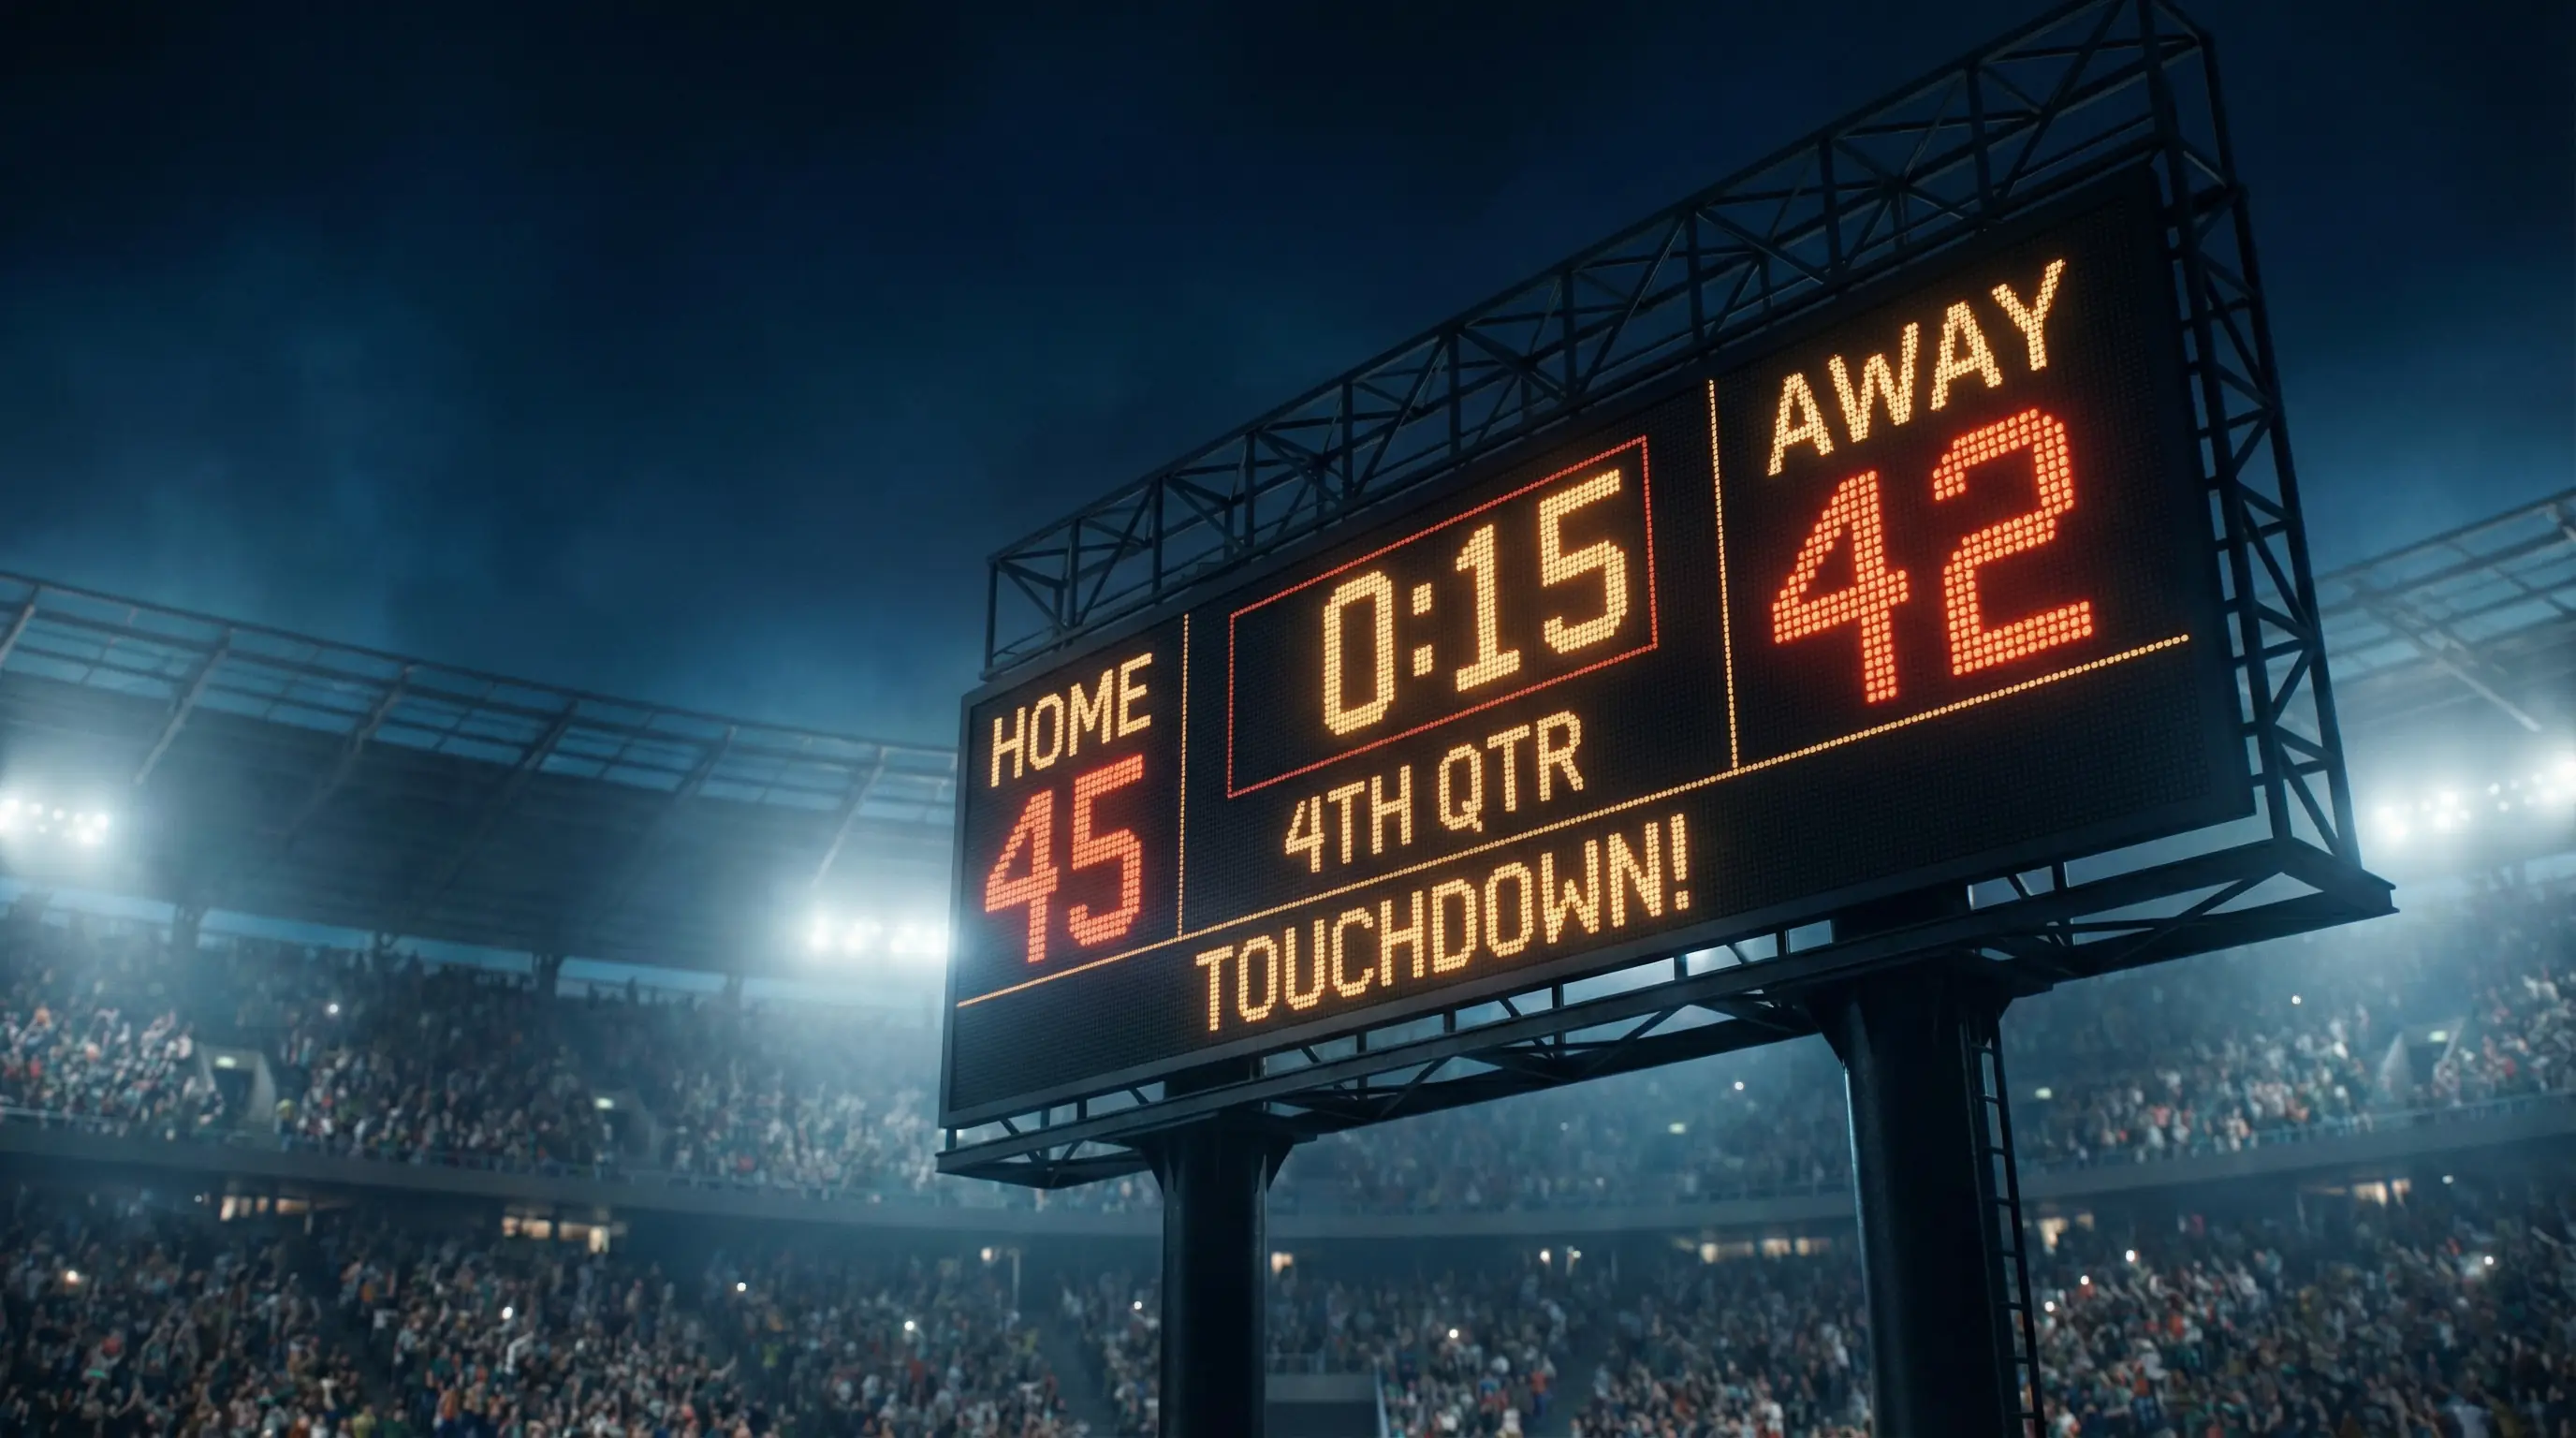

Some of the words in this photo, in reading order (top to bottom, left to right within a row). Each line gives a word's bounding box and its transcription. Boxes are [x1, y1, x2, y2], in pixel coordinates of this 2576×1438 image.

[1768, 259, 2065, 477] AWAY
[1323, 469, 1629, 736] 0:15
[1772, 408, 2093, 704] 42
[990, 653, 1152, 788] HOME
[1284, 764, 1412, 873] 4TH
[1439, 710, 1585, 832] QTR
[985, 754, 1144, 963] 45
[1196, 813, 1690, 1032] TOUCHDOWN!
